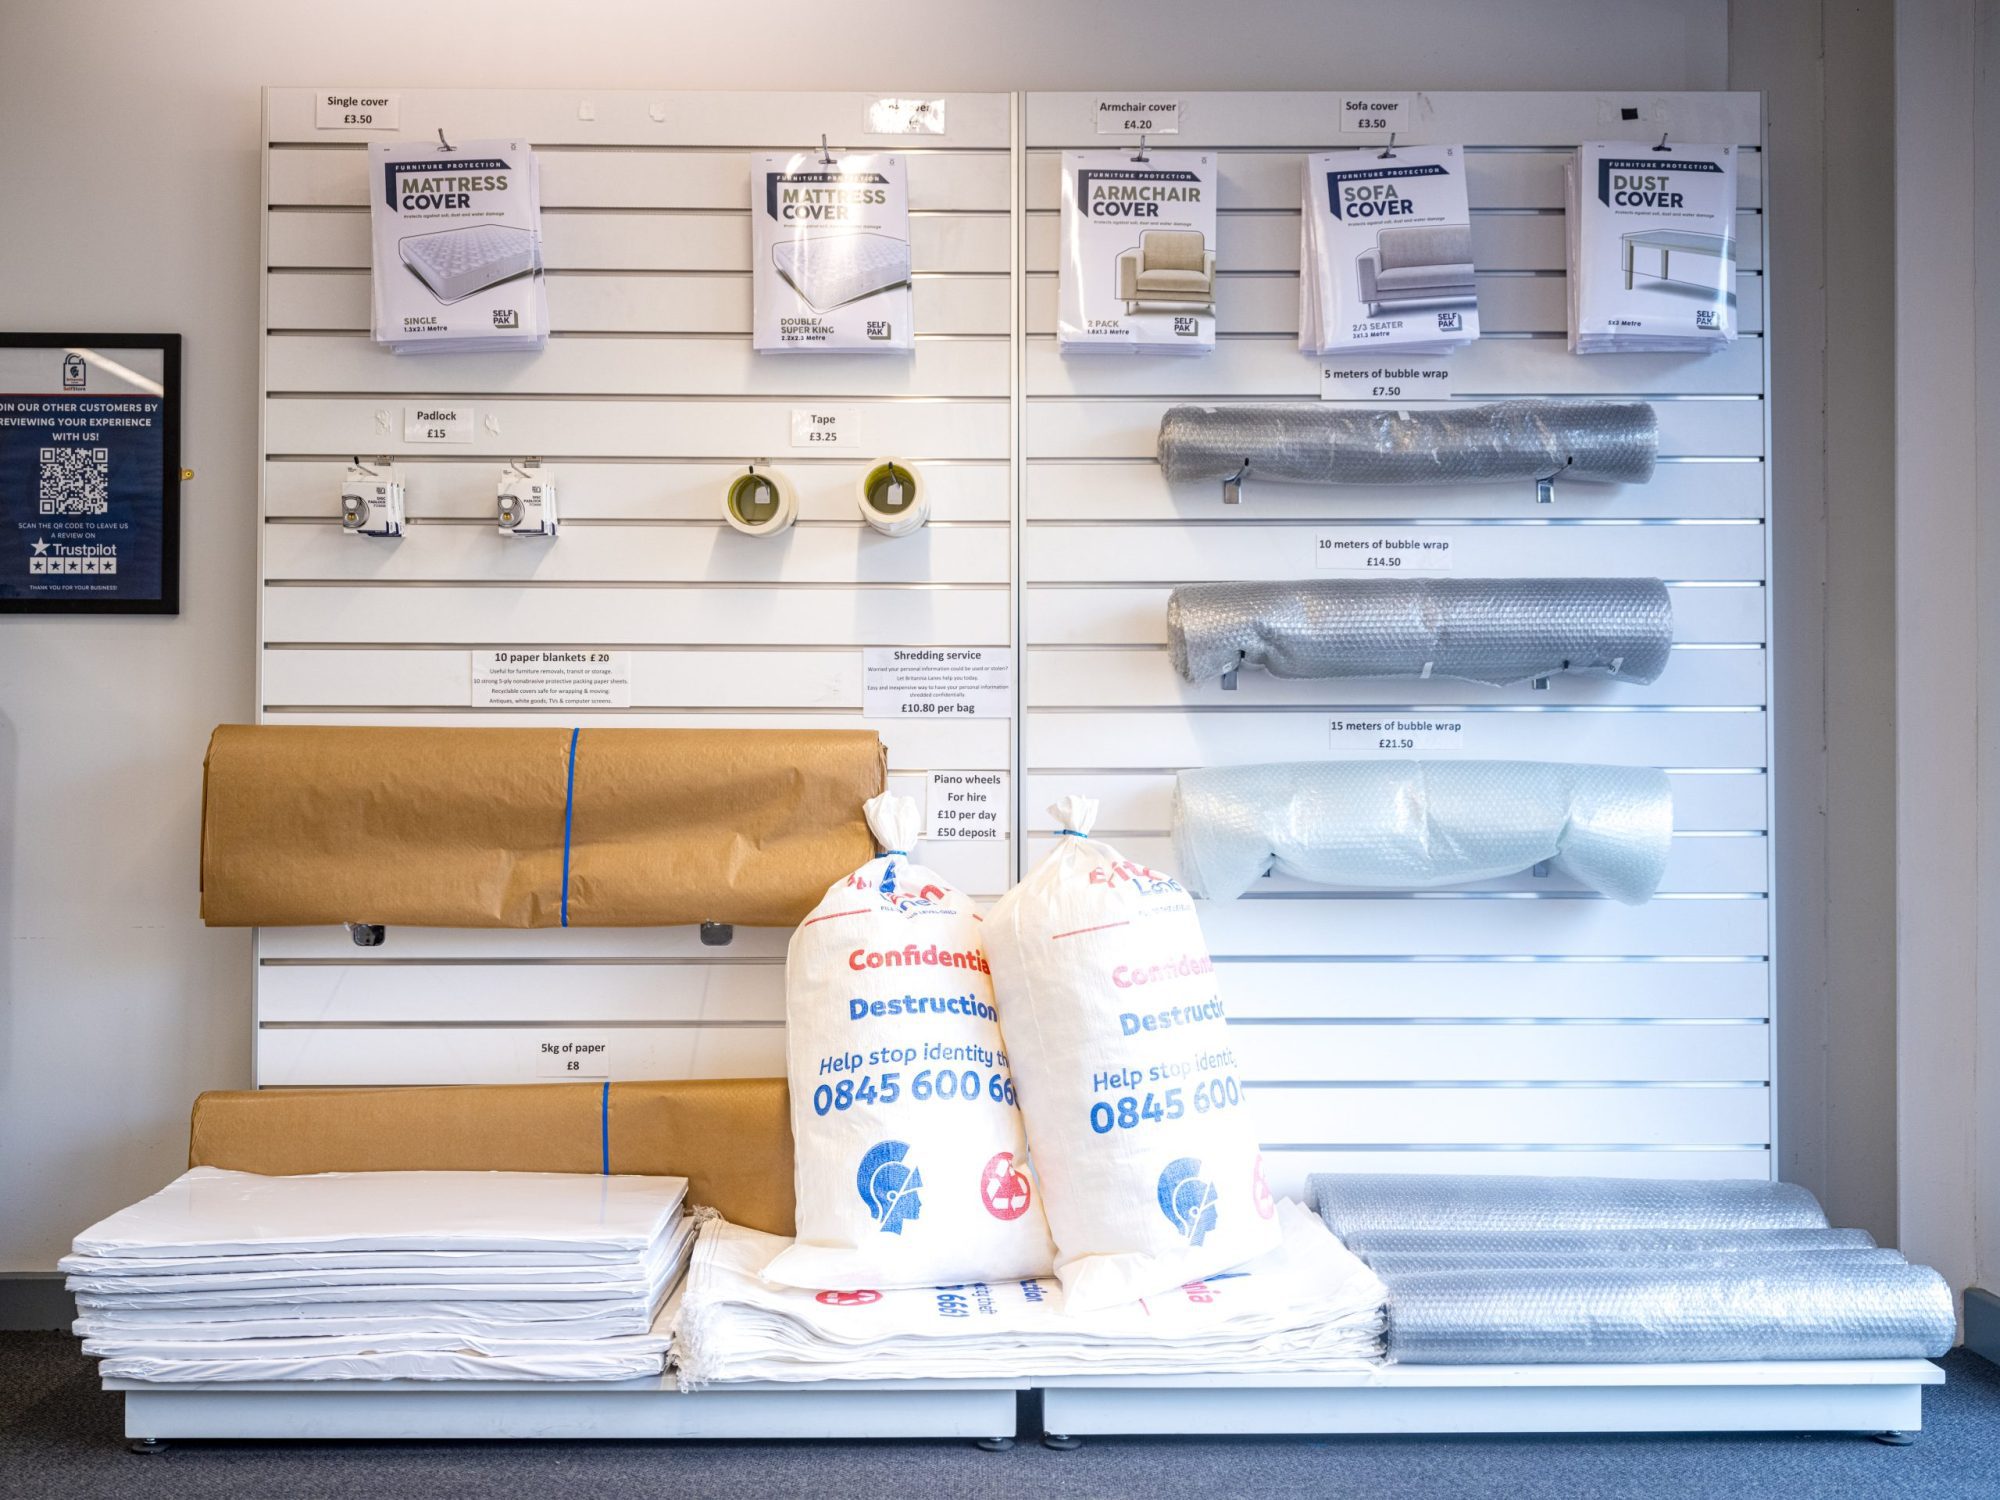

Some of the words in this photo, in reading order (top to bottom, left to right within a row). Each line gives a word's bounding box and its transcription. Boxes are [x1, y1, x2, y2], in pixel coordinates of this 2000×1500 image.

[328, 97, 358, 107] Single
[1346, 101, 1368, 111] Sofa
[1371, 103, 1398, 111] cover
[1100, 103, 1146, 112] Armchair
[1149, 104, 1176, 112] cover
[344, 115, 372, 124] £3.50
[1124, 120, 1152, 129] £4.20
[1358, 119, 1386, 128] £3.50
[1337, 171, 1384, 180] FURNITURE
[1388, 168, 1440, 176] PROTECTION
[402, 176, 508, 193] MATTRESS
[1614, 175, 1669, 191] DUST
[783, 189, 885, 204] MATTRESS
[1093, 186, 1201, 202] ARMCHAIR
[1344, 184, 1398, 201] SOFA
[402, 194, 470, 210] COVER
[1615, 192, 1684, 208] COVER
[783, 205, 849, 220] COVER
[1093, 202, 1158, 217] COVER
[1346, 199, 1414, 217] COVER
[1696, 310, 1716, 318] SELF
[404, 317, 437, 325] SINGLE
[1438, 320, 1454, 328] PAK
[1353, 324, 1367, 332] 2/3
[1370, 321, 1403, 330] SEATER
[1325, 370, 1330, 379] 5
[1334, 370, 1369, 379] meters
[1372, 369, 1382, 379] of
[1384, 369, 1419, 378] bubble
[1423, 370, 1448, 380] wrap
[1372, 387, 1400, 396] £7.50
[80, 404, 142, 412] CUSTOMERS
[144, 404, 157, 412] BY
[417, 411, 456, 421] Padlock
[811, 415, 836, 425] Tape
[0, 418, 55, 426] REVIEWING
[58, 418, 87, 426] YOUR
[90, 418, 151, 427] EXPERIENCE
[52, 433, 80, 441] WITH
[82, 433, 99, 441] US!
[427, 429, 446, 438] £15
[810, 432, 837, 441] £3.25
[1320, 540, 1331, 549] 10
[1334, 540, 1369, 549] meters
[1372, 540, 1382, 549] of
[1386, 540, 1420, 549] bubble
[1423, 541, 1449, 551] wrap
[53, 544, 117, 558] Trustpilot
[1367, 558, 1401, 566] £14.50
[495, 653, 507, 662] 10
[510, 654, 539, 663] paper
[543, 653, 586, 661] blankets
[590, 654, 595, 662] £
[598, 654, 609, 662] 20
[894, 651, 944, 661] Shredding
[946, 651, 981, 660] service
[902, 704, 935, 713] £10.80
[938, 705, 954, 714] per
[957, 704, 975, 713] bag
[1331, 721, 1343, 730] 15
[1346, 722, 1382, 730] meters
[1384, 721, 1394, 730] of
[1398, 721, 1432, 730] bubble
[1435, 722, 1461, 732] wrap
[1379, 739, 1413, 748] £21.50
[934, 775, 962, 783] Piano
[965, 775, 1000, 784] wheels
[948, 793, 964, 801] For
[967, 792, 987, 801] hire
[938, 810, 956, 819] £10
[959, 812, 976, 821] per
[978, 810, 996, 821] day
[938, 828, 956, 836] £50
[958, 828, 996, 838] deposit
[848, 944, 991, 976] Confidentia
[850, 994, 998, 1023] Destruction
[541, 1043, 560, 1054] 5kg
[562, 1043, 573, 1052] of
[576, 1044, 605, 1054] paper
[819, 1052, 862, 1075] Help
[869, 1046, 917, 1066] stop
[924, 1043, 993, 1067] identity
[567, 1061, 580, 1070] £8
[1093, 1068, 1142, 1092] Help
[1149, 1061, 1191, 1082] stop
[1195, 1048, 1237, 1072] identit
[813, 1072, 900, 1117] 0845
[912, 1070, 981, 1101] 600
[988, 1074, 1020, 1111] 66
[1090, 1087, 1184, 1134] 0845
[1193, 1076, 1238, 1114] 600
